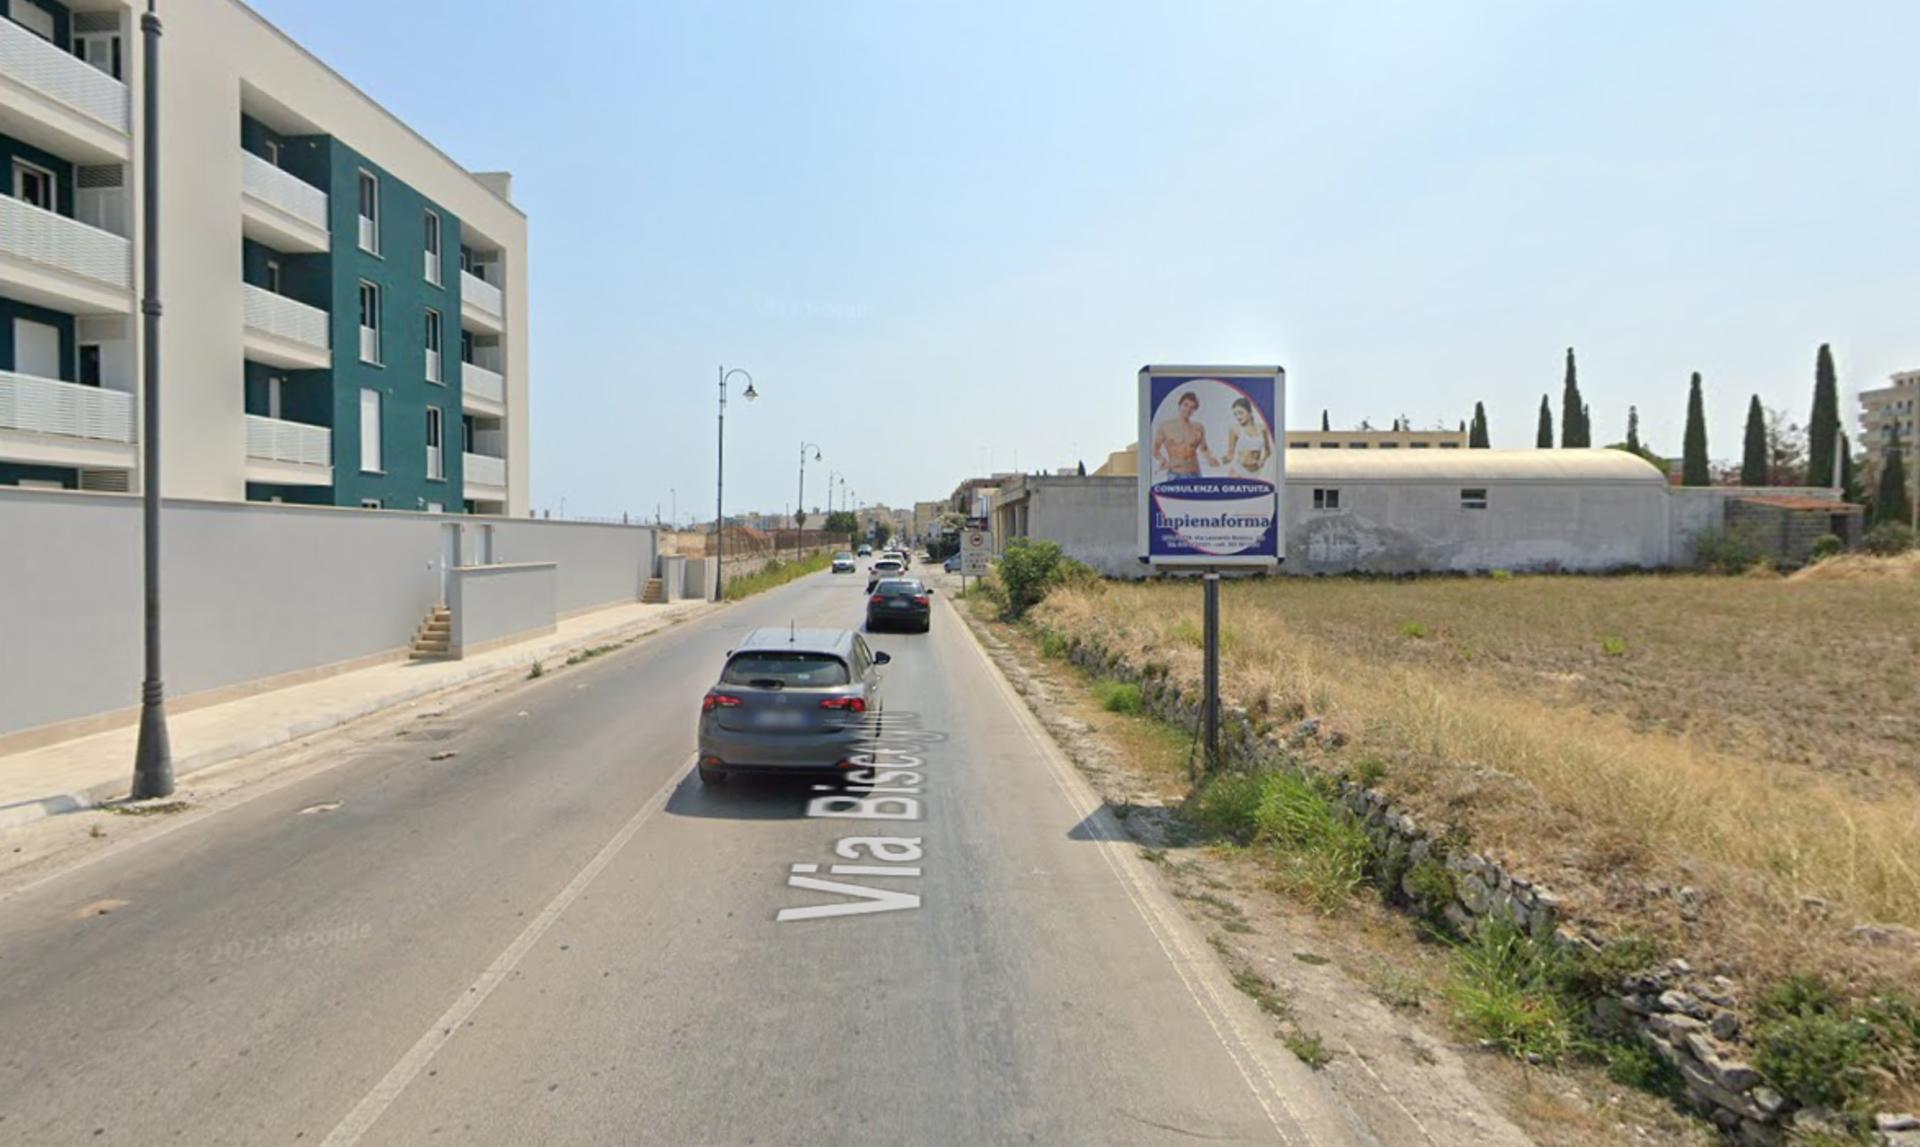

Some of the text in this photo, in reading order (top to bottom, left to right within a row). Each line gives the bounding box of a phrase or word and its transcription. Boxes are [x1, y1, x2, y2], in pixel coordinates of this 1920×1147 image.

[1154, 484, 1270, 493] CONSULENZA GRATUITA
[1156, 513, 1271, 529] Inpienaforma
